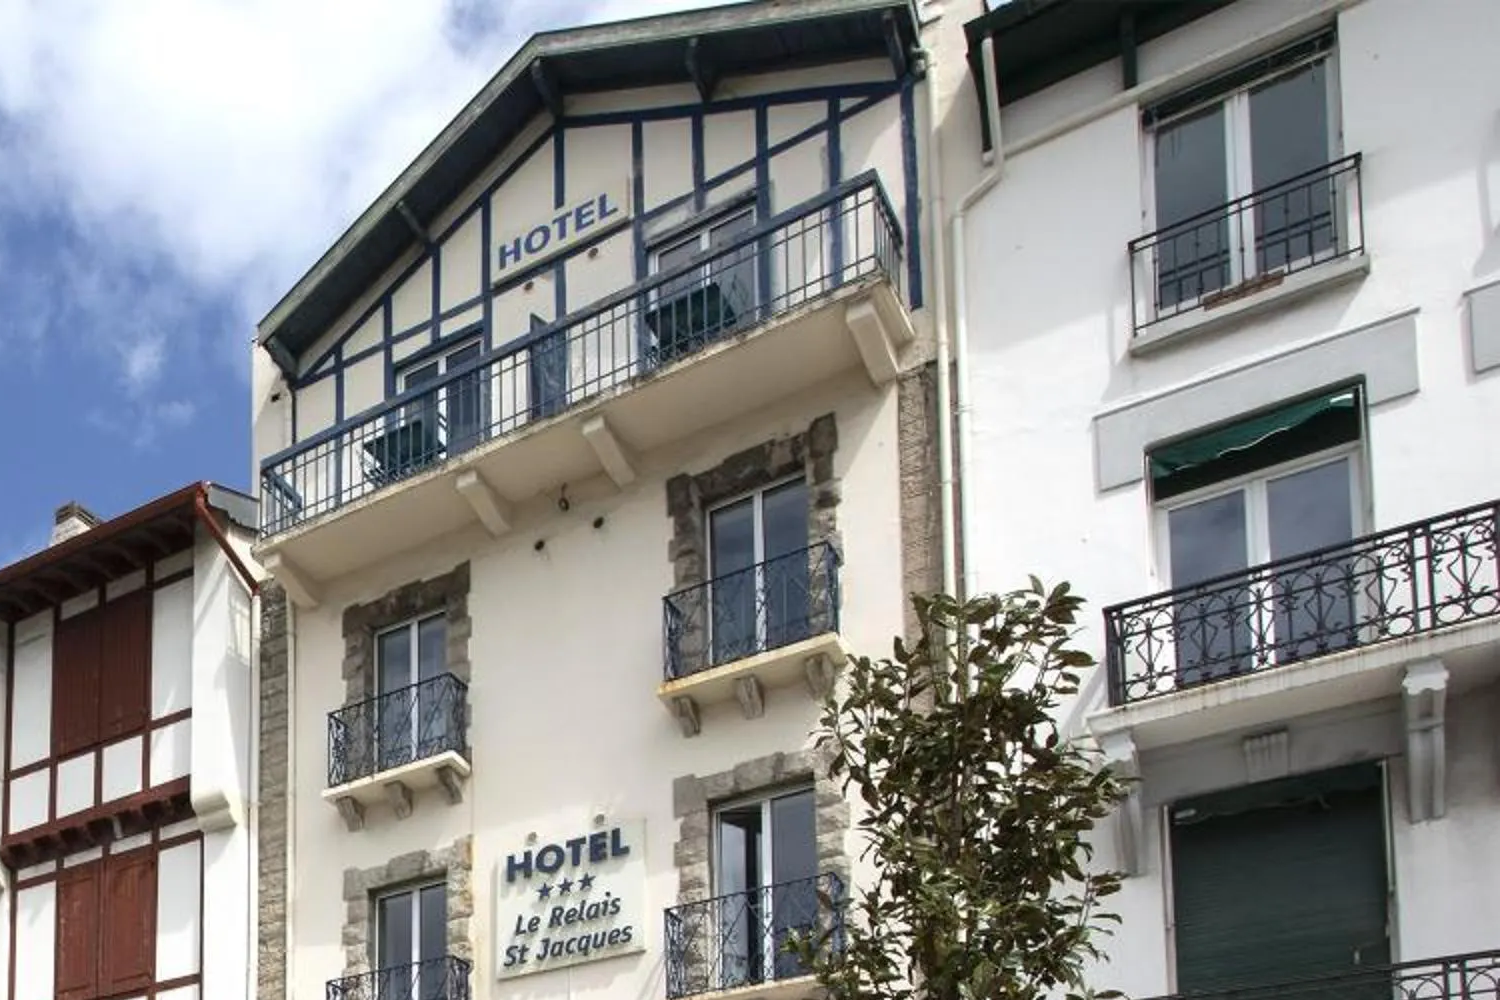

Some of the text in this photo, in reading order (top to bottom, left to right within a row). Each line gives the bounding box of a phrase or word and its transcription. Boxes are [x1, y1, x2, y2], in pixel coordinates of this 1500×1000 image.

[498, 193, 618, 270] HOTEL
[506, 827, 631, 884] HOTEL
[514, 891, 622, 936] Le Relais
[503, 925, 633, 968] St Jacques
